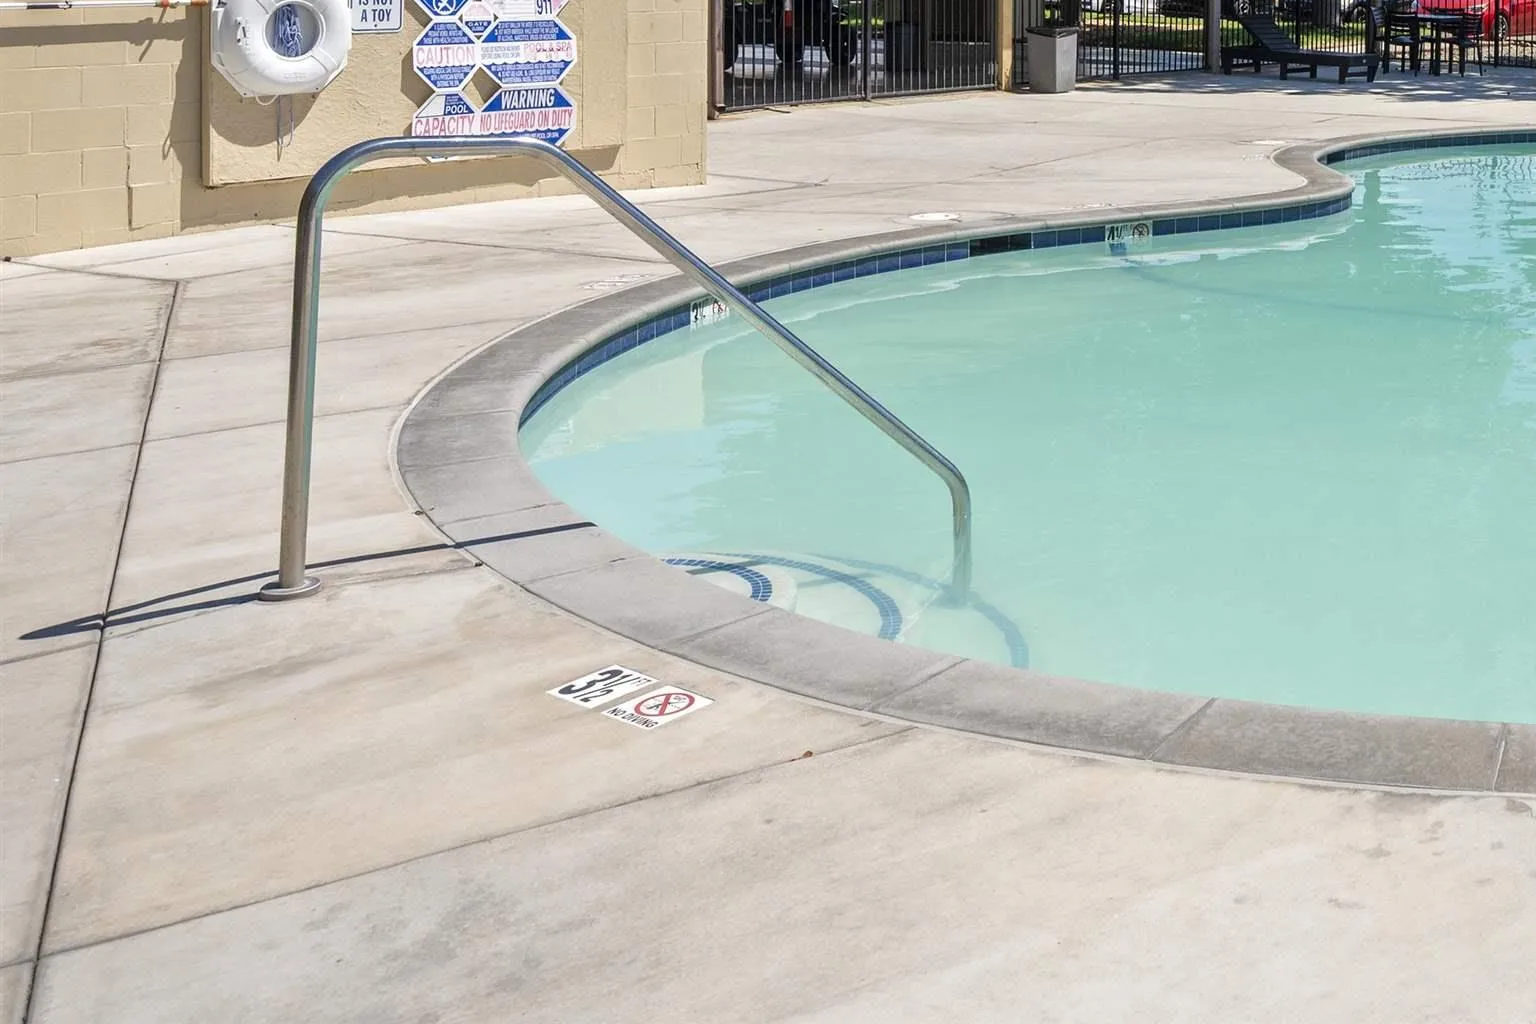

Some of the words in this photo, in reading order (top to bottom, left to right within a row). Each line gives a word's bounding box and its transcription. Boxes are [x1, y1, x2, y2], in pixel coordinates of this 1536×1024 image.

[361, 9, 367, 22] A
[372, 9, 392, 22] TOY
[416, 47, 475, 65] CAUTION
[501, 89, 555, 109] WARNING
[445, 105, 469, 114] POOL
[415, 116, 474, 136] CAPACITY
[480, 114, 492, 132] NO
[494, 111, 536, 131] LIFEGUARD
[538, 110, 549, 127] ON
[552, 109, 573, 126] DUTY
[606, 707, 626, 716] NO
[621, 713, 659, 727] DIVING
